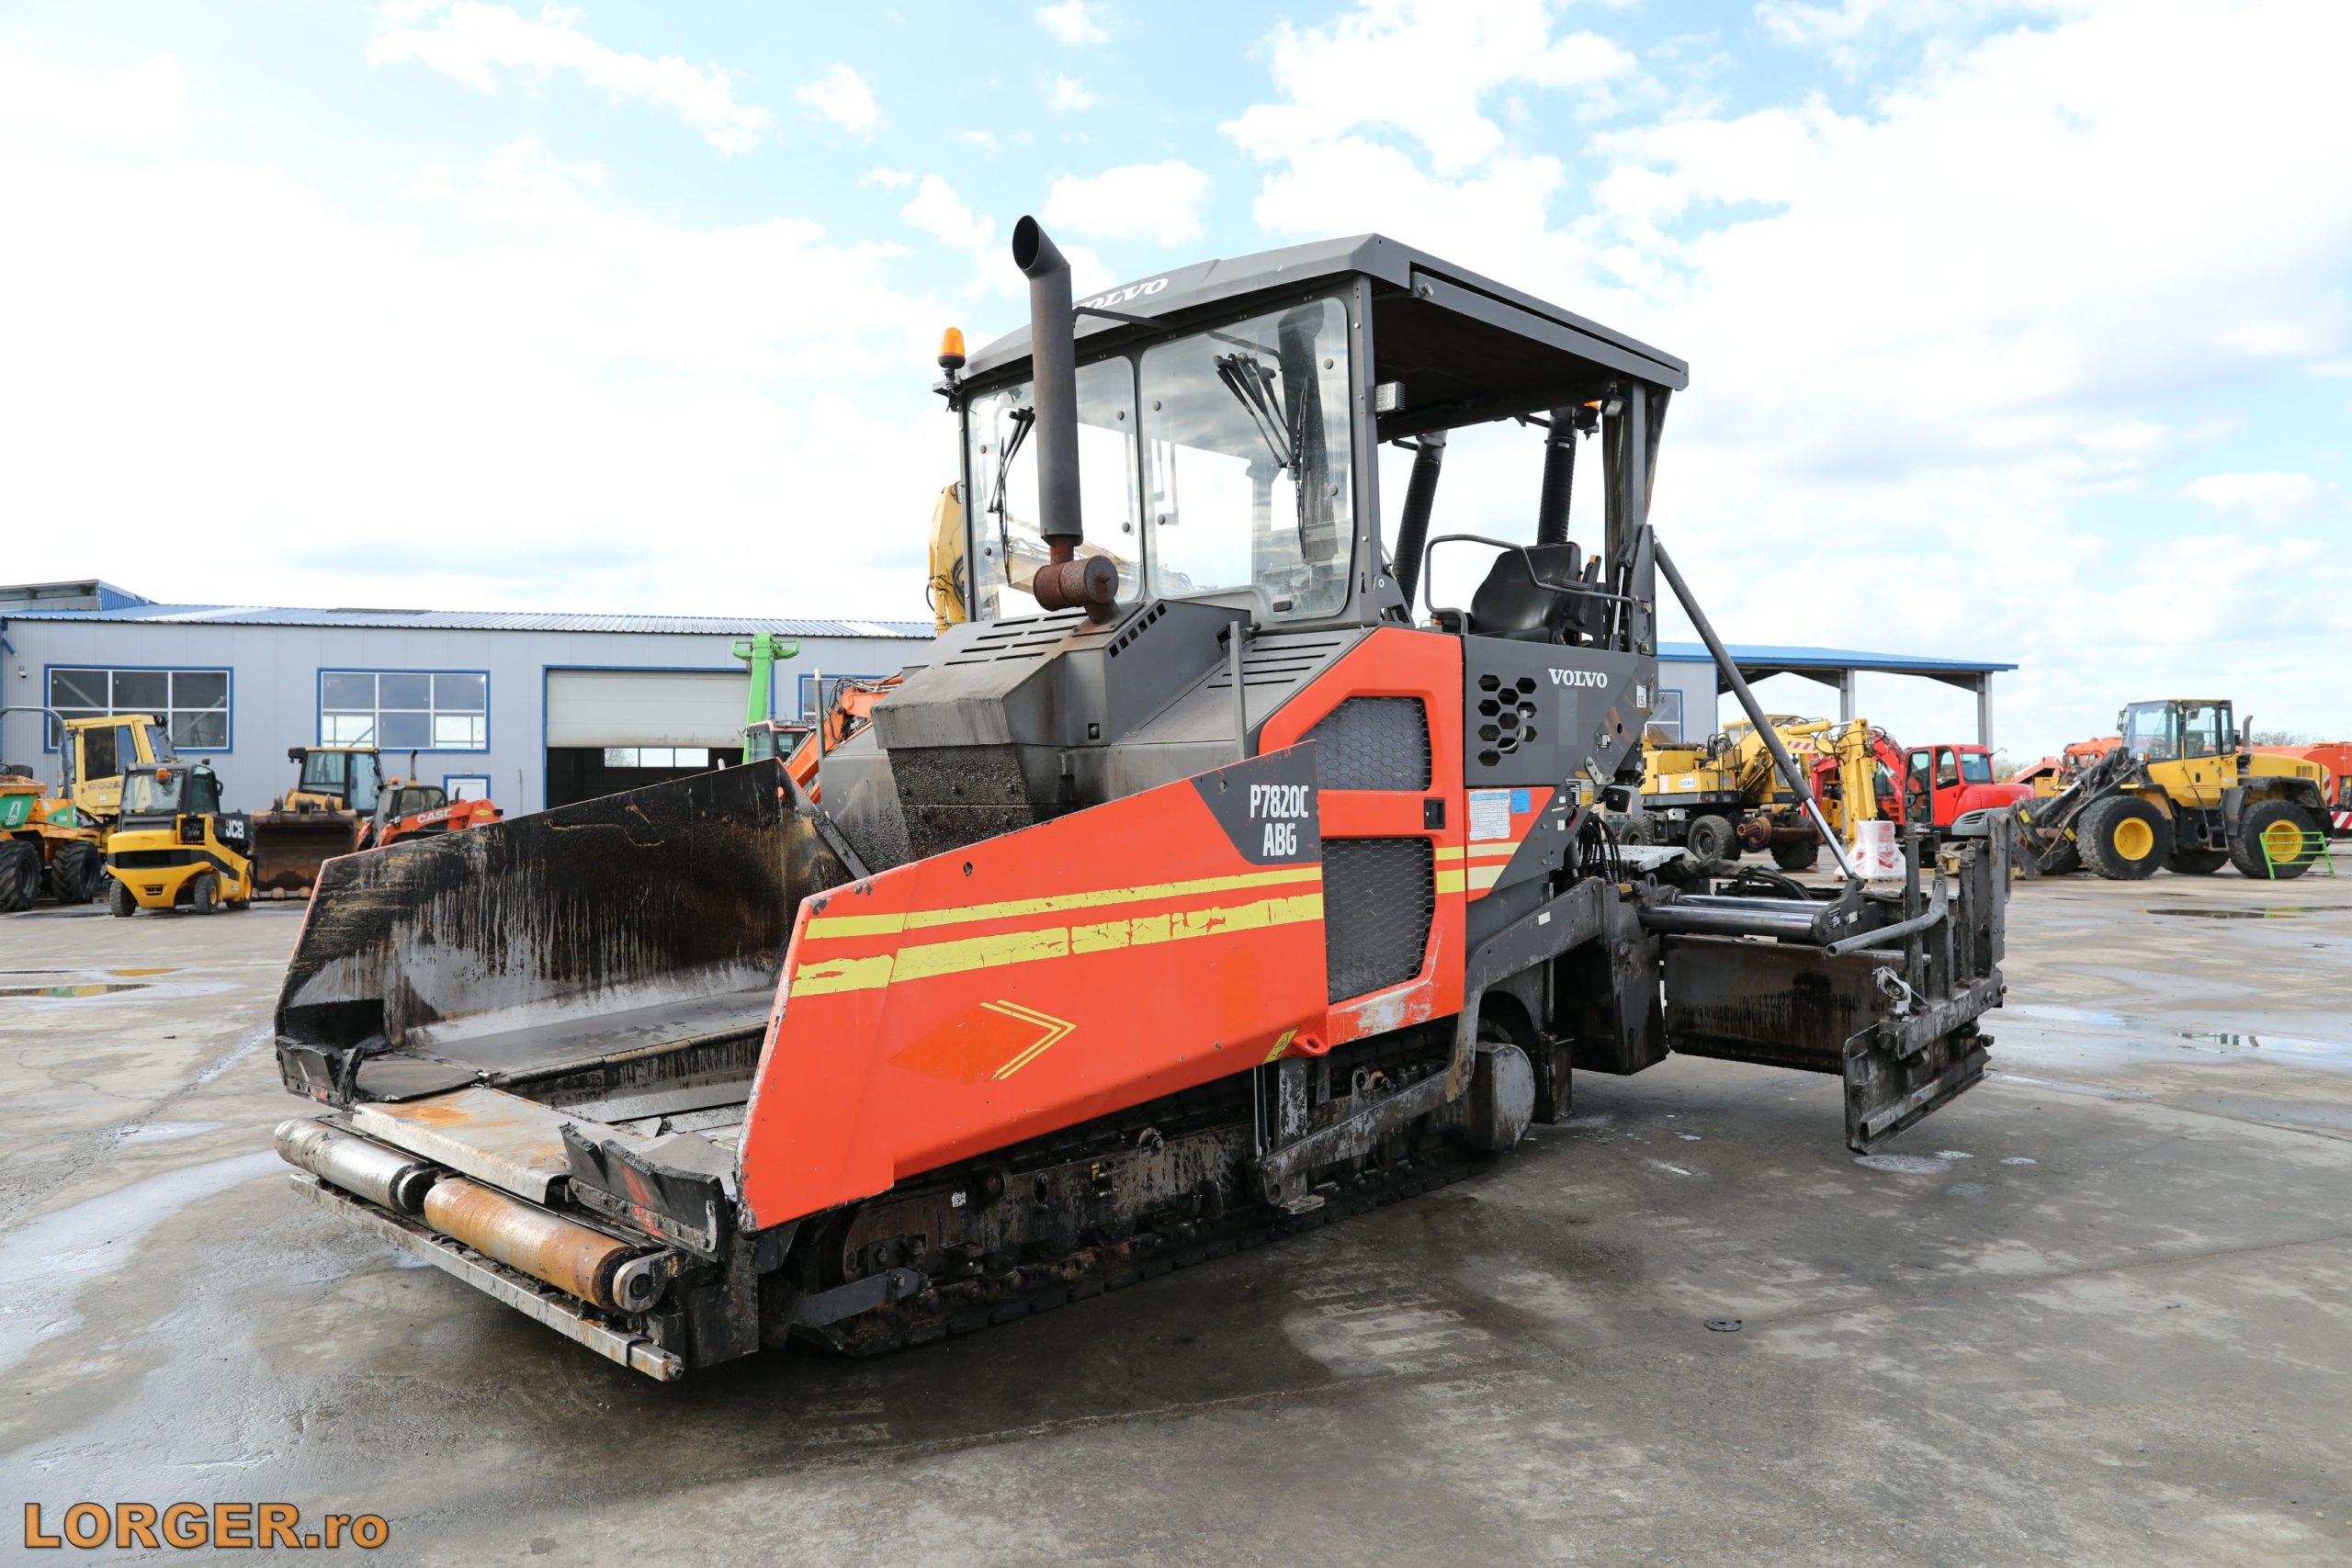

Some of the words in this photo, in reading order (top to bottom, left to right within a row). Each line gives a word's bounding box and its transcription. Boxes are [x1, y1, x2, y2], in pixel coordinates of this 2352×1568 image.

[1072, 277, 1169, 310] OLVO
[1547, 668, 1608, 689] VOLVO
[1250, 784, 1309, 818] P7820C
[225, 818, 244, 840] JCB
[1262, 822, 1297, 857] ABG
